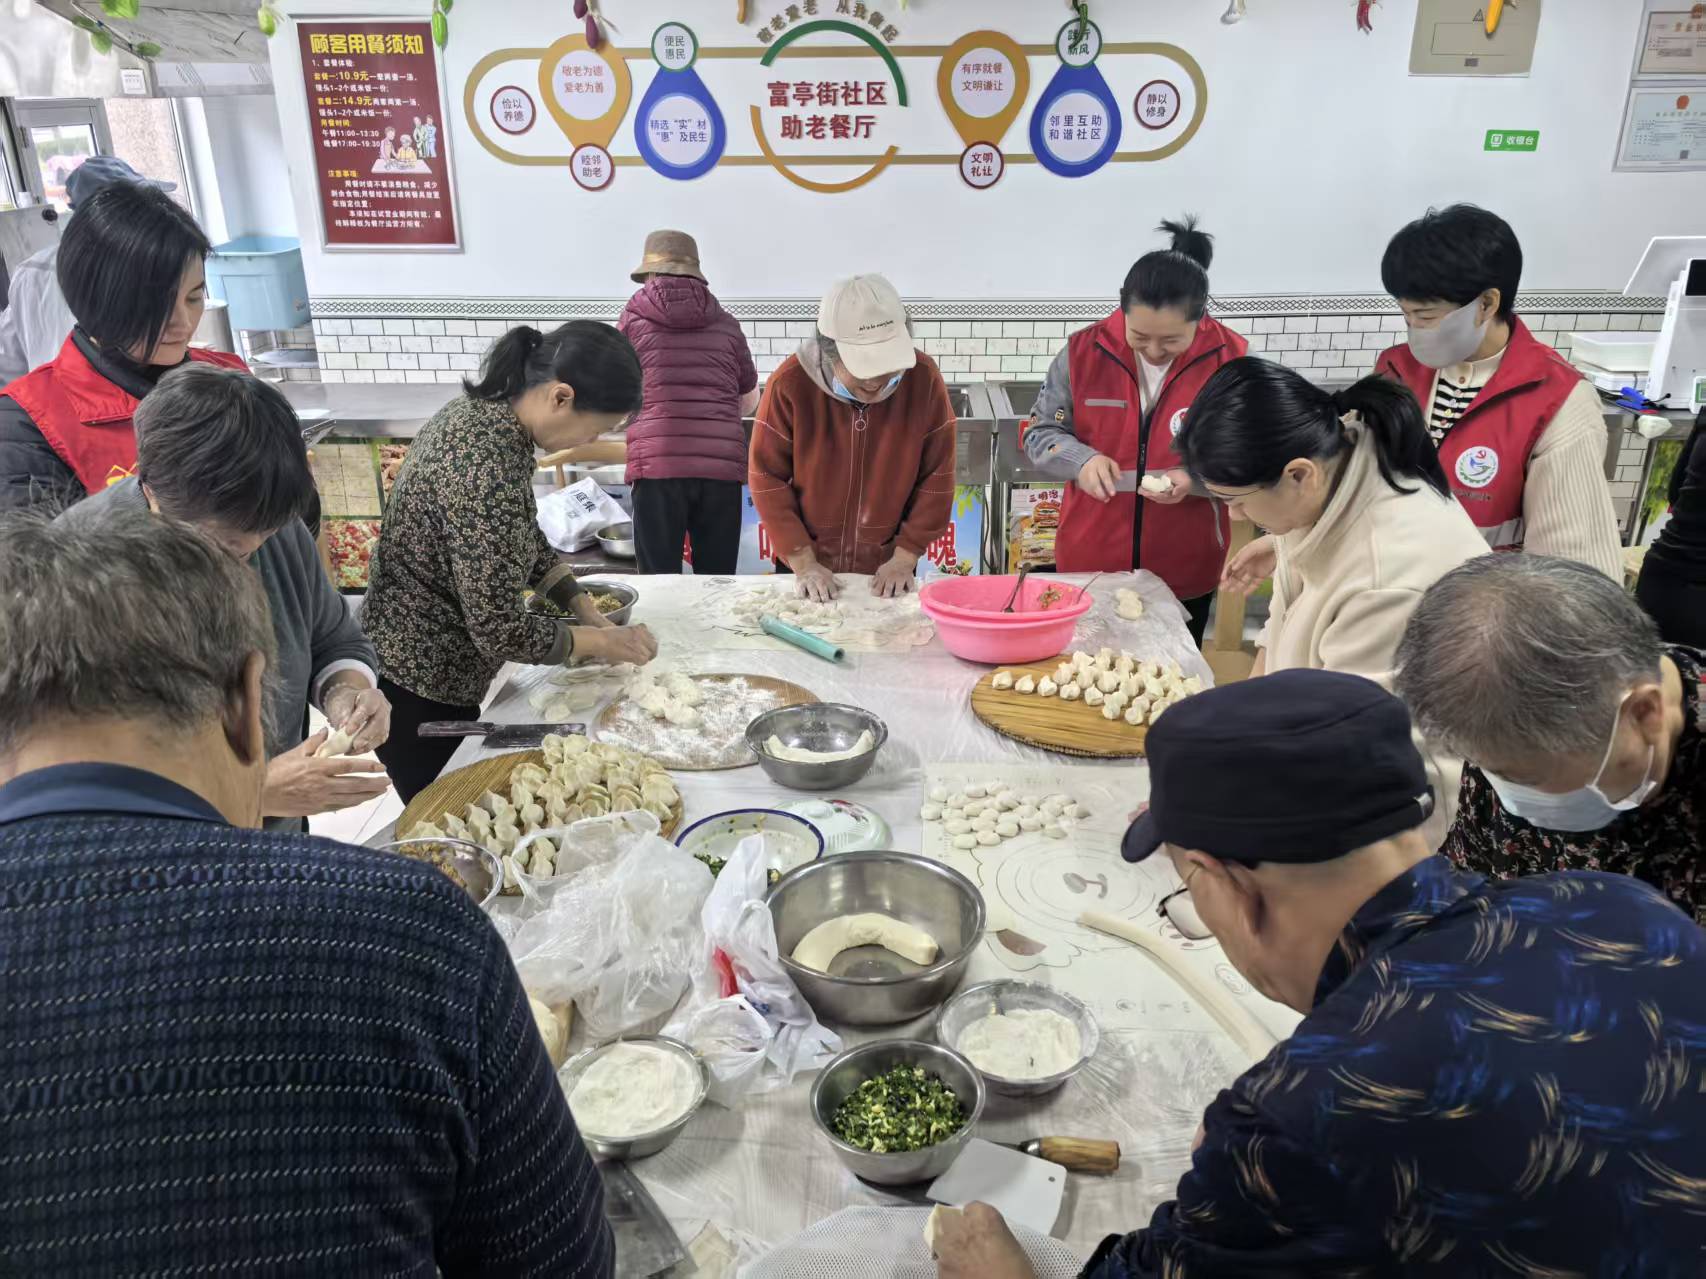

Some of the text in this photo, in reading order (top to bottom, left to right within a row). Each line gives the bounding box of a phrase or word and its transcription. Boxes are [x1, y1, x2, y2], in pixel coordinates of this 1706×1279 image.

[309, 33, 424, 55] 顾客用餐须知
[664, 35, 685, 47] 便民
[665, 48, 687, 60] 惠民
[562, 65, 604, 77] 敬老为德
[961, 62, 1003, 75] 有序就餐
[564, 81, 604, 94] 爱老为善
[961, 79, 1004, 92] 文明谦让
[767, 80, 887, 107] 富亭街社区
[1146, 93, 1167, 105] 静以
[502, 98, 523, 110] 俭以
[503, 110, 525, 123] 养德
[1146, 106, 1166, 118] 修身
[780, 115, 876, 139] 助老餐厅
[1049, 115, 1102, 127] 邻里互助
[1049, 128, 1102, 140] 和谐社区
[581, 154, 602, 166] 睦邻
[971, 152, 994, 164] 文明
[582, 166, 603, 179] 助老
[971, 165, 993, 178] 礼让
